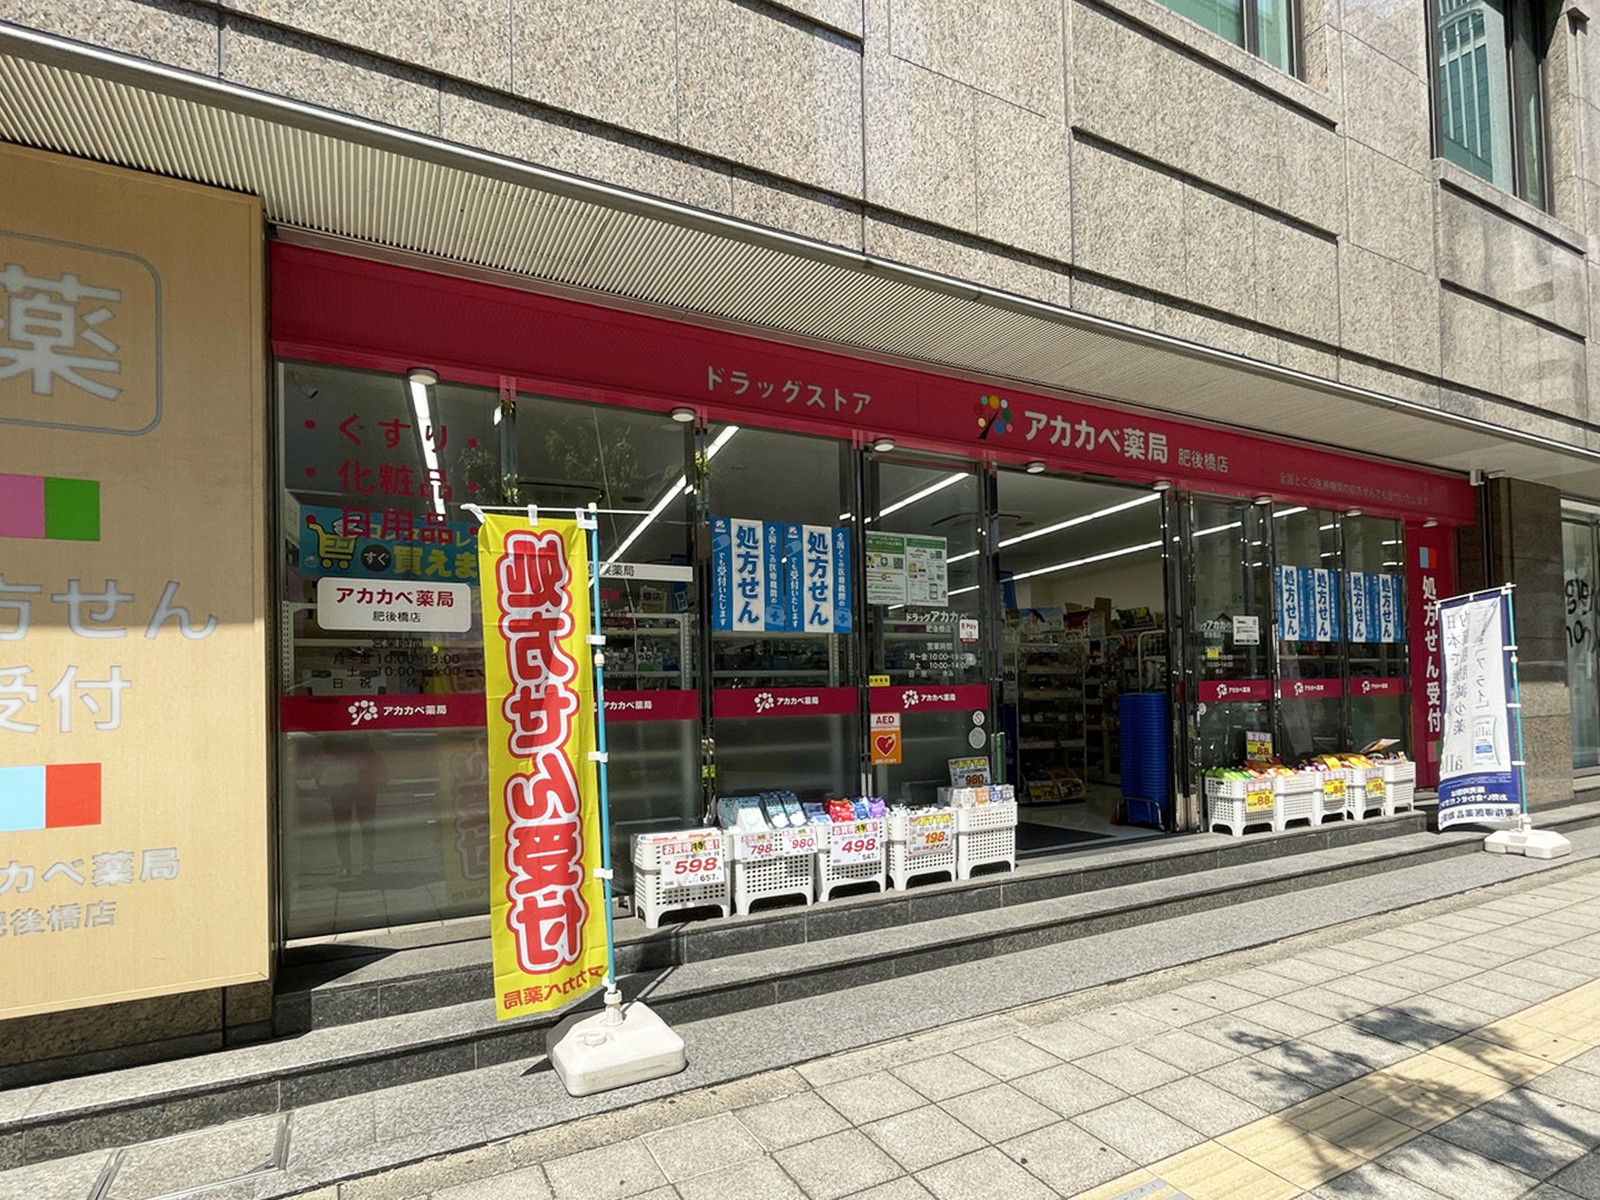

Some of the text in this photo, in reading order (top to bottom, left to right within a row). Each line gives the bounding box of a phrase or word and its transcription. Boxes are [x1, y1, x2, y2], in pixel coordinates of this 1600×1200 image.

[0, 263, 123, 401] 薬
[707, 365, 872, 415] ドラッグストア
[338, 413, 447, 452] くすり
[1024, 410, 1230, 474] アカカベ薬局 肥後橋店
[337, 459, 453, 500] 化粧品
[341, 506, 453, 544] 日用品
[363, 552, 388, 567] すぐ
[735, 525, 760, 624] 処方せん
[807, 531, 829, 626] 処方せん
[336, 587, 455, 608] アカカベ薬局
[372, 610, 421, 624] 肥後橋店
[1422, 575, 1442, 734] 処方せん受付
[383, 704, 447, 716] アカカベ薬局
[876, 715, 895, 725] AED
[966, 773, 985, 786] 980
[792, 837, 814, 849] 980
[841, 838, 876, 853] 498
[925, 831, 946, 844] 198
[750, 843, 773, 855] 798
[674, 857, 718, 875] 598
[700, 873, 716, 882] 657
